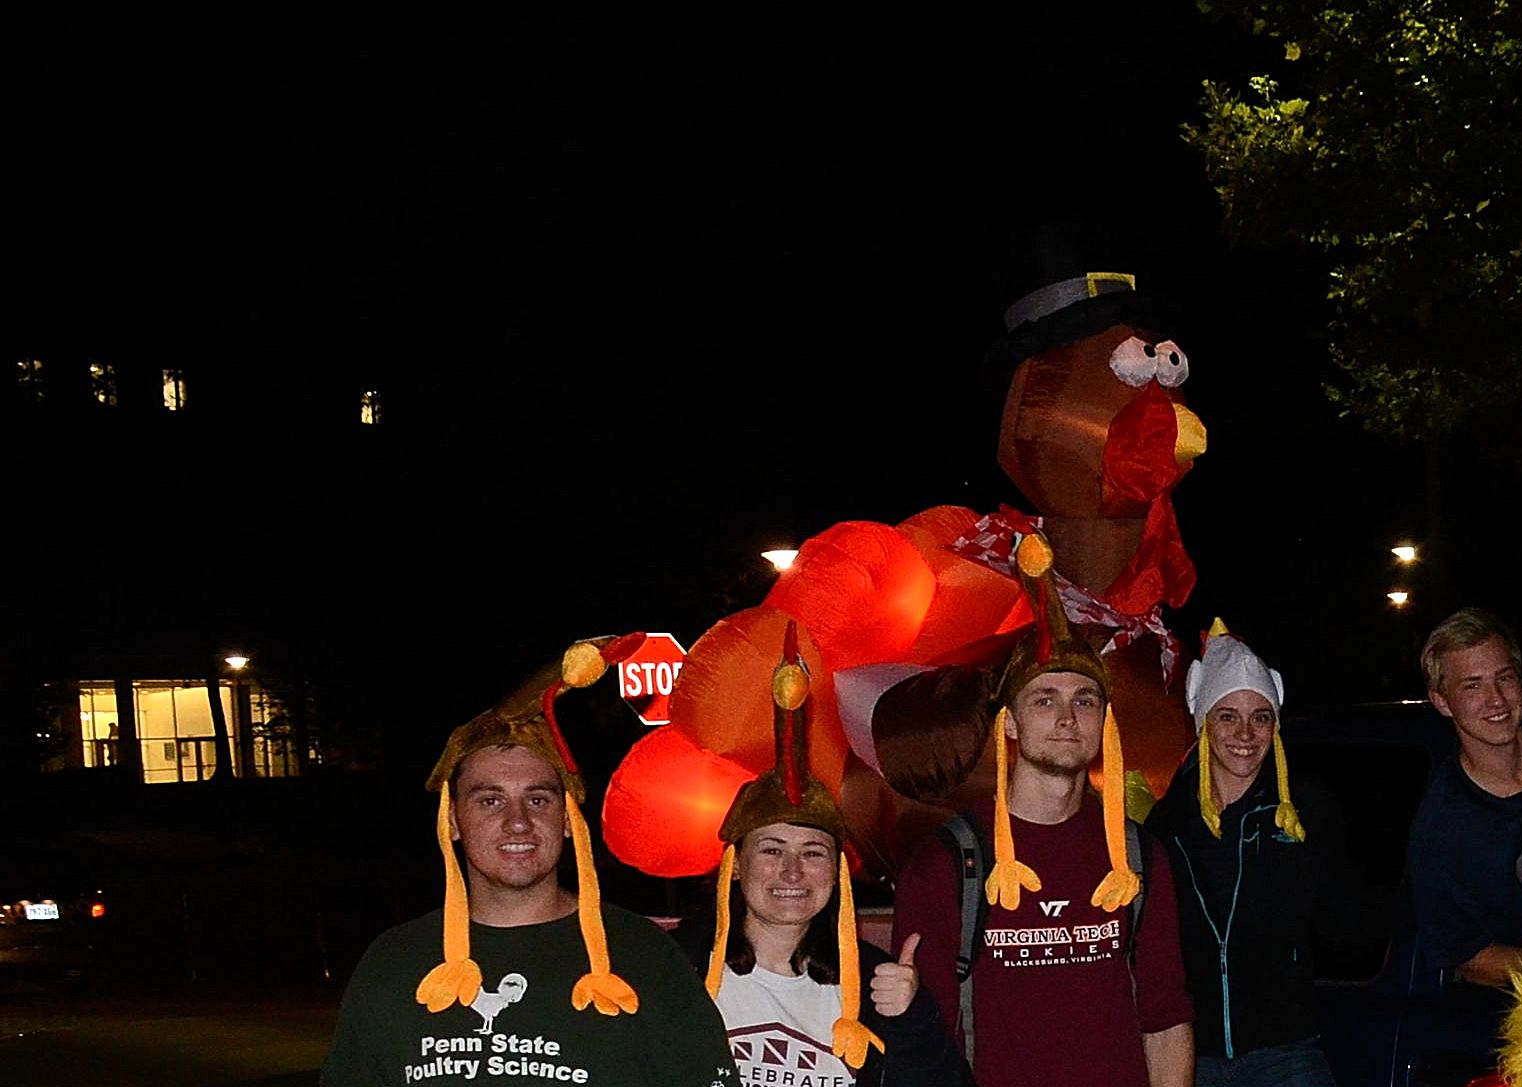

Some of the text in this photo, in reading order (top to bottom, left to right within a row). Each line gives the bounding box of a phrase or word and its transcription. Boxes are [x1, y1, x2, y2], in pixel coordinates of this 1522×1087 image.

[1039, 900, 1070, 917] VT
[984, 927, 1072, 946] VIRGINIA
[993, 940, 1120, 958] HOKIES
[1071, 952, 1112, 963] VIRGINIA
[421, 1033, 561, 1056] Penn State
[404, 1056, 590, 1084] Poultry Science
